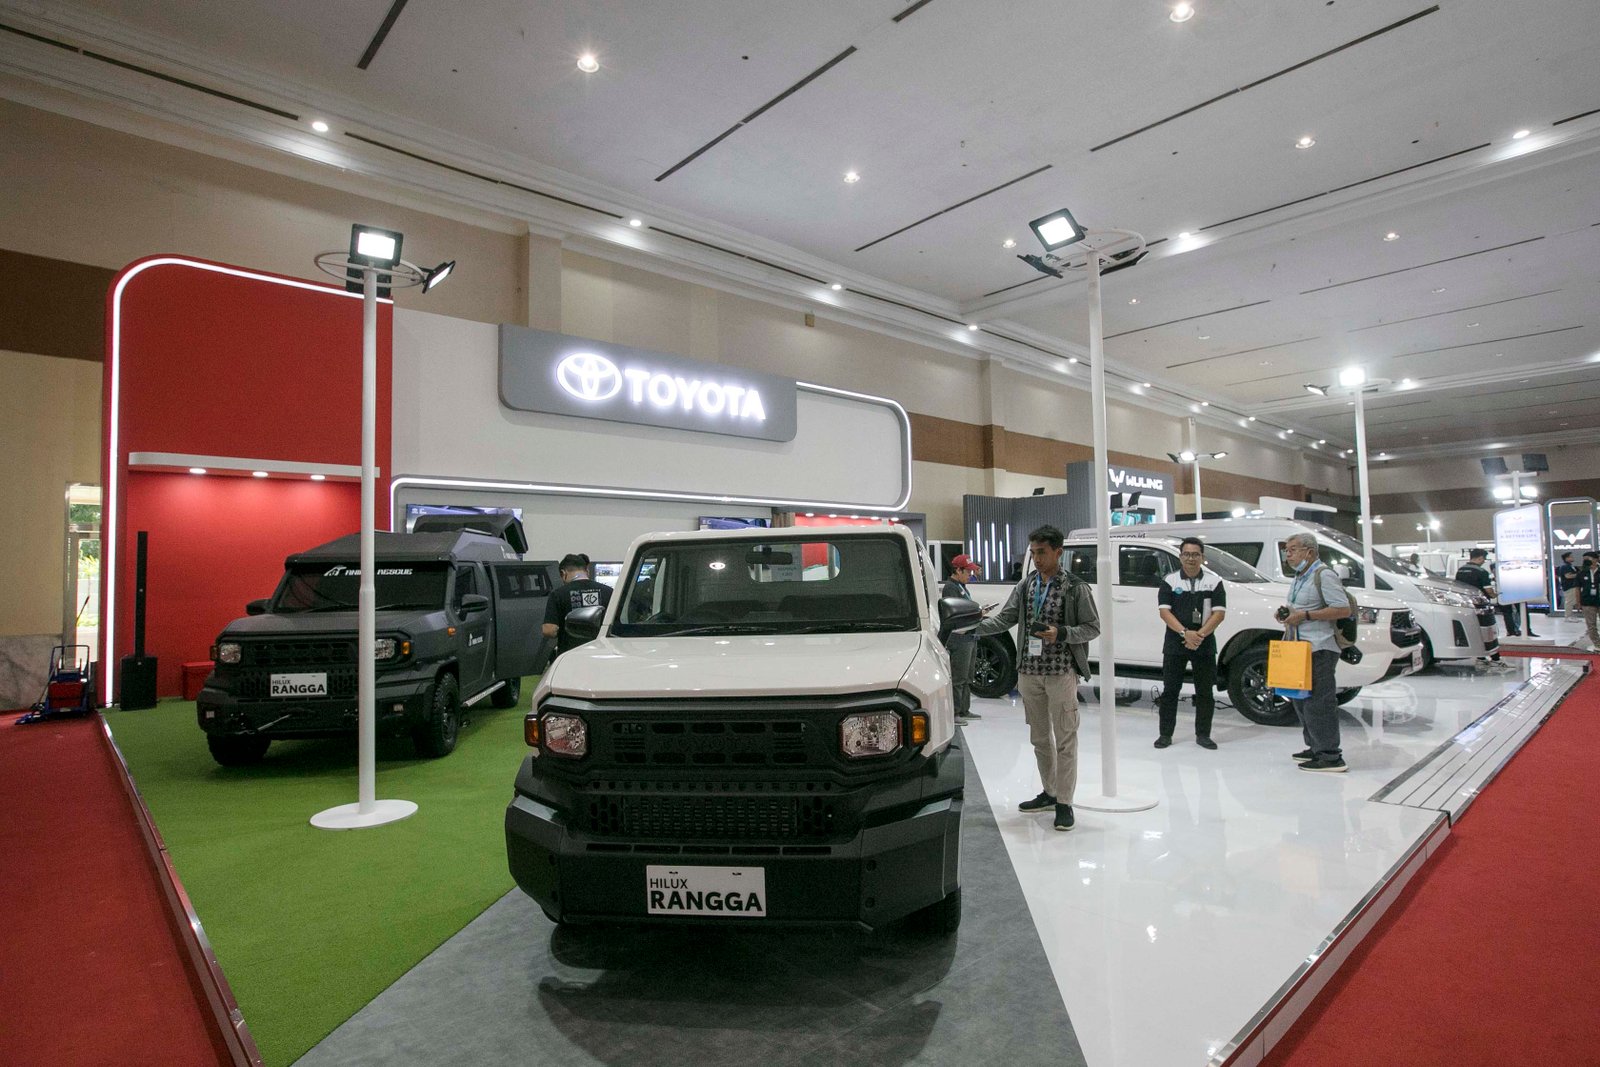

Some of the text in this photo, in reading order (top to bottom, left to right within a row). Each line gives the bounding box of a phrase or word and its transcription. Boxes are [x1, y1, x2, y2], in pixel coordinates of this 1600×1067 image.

[624, 368, 766, 421] TOYOTA
[1126, 475, 1163, 490] WULING
[377, 568, 413, 576] RESCUE
[272, 684, 325, 694] RANGGA
[650, 879, 688, 889] HILUX
[650, 891, 763, 912] RANGGA
